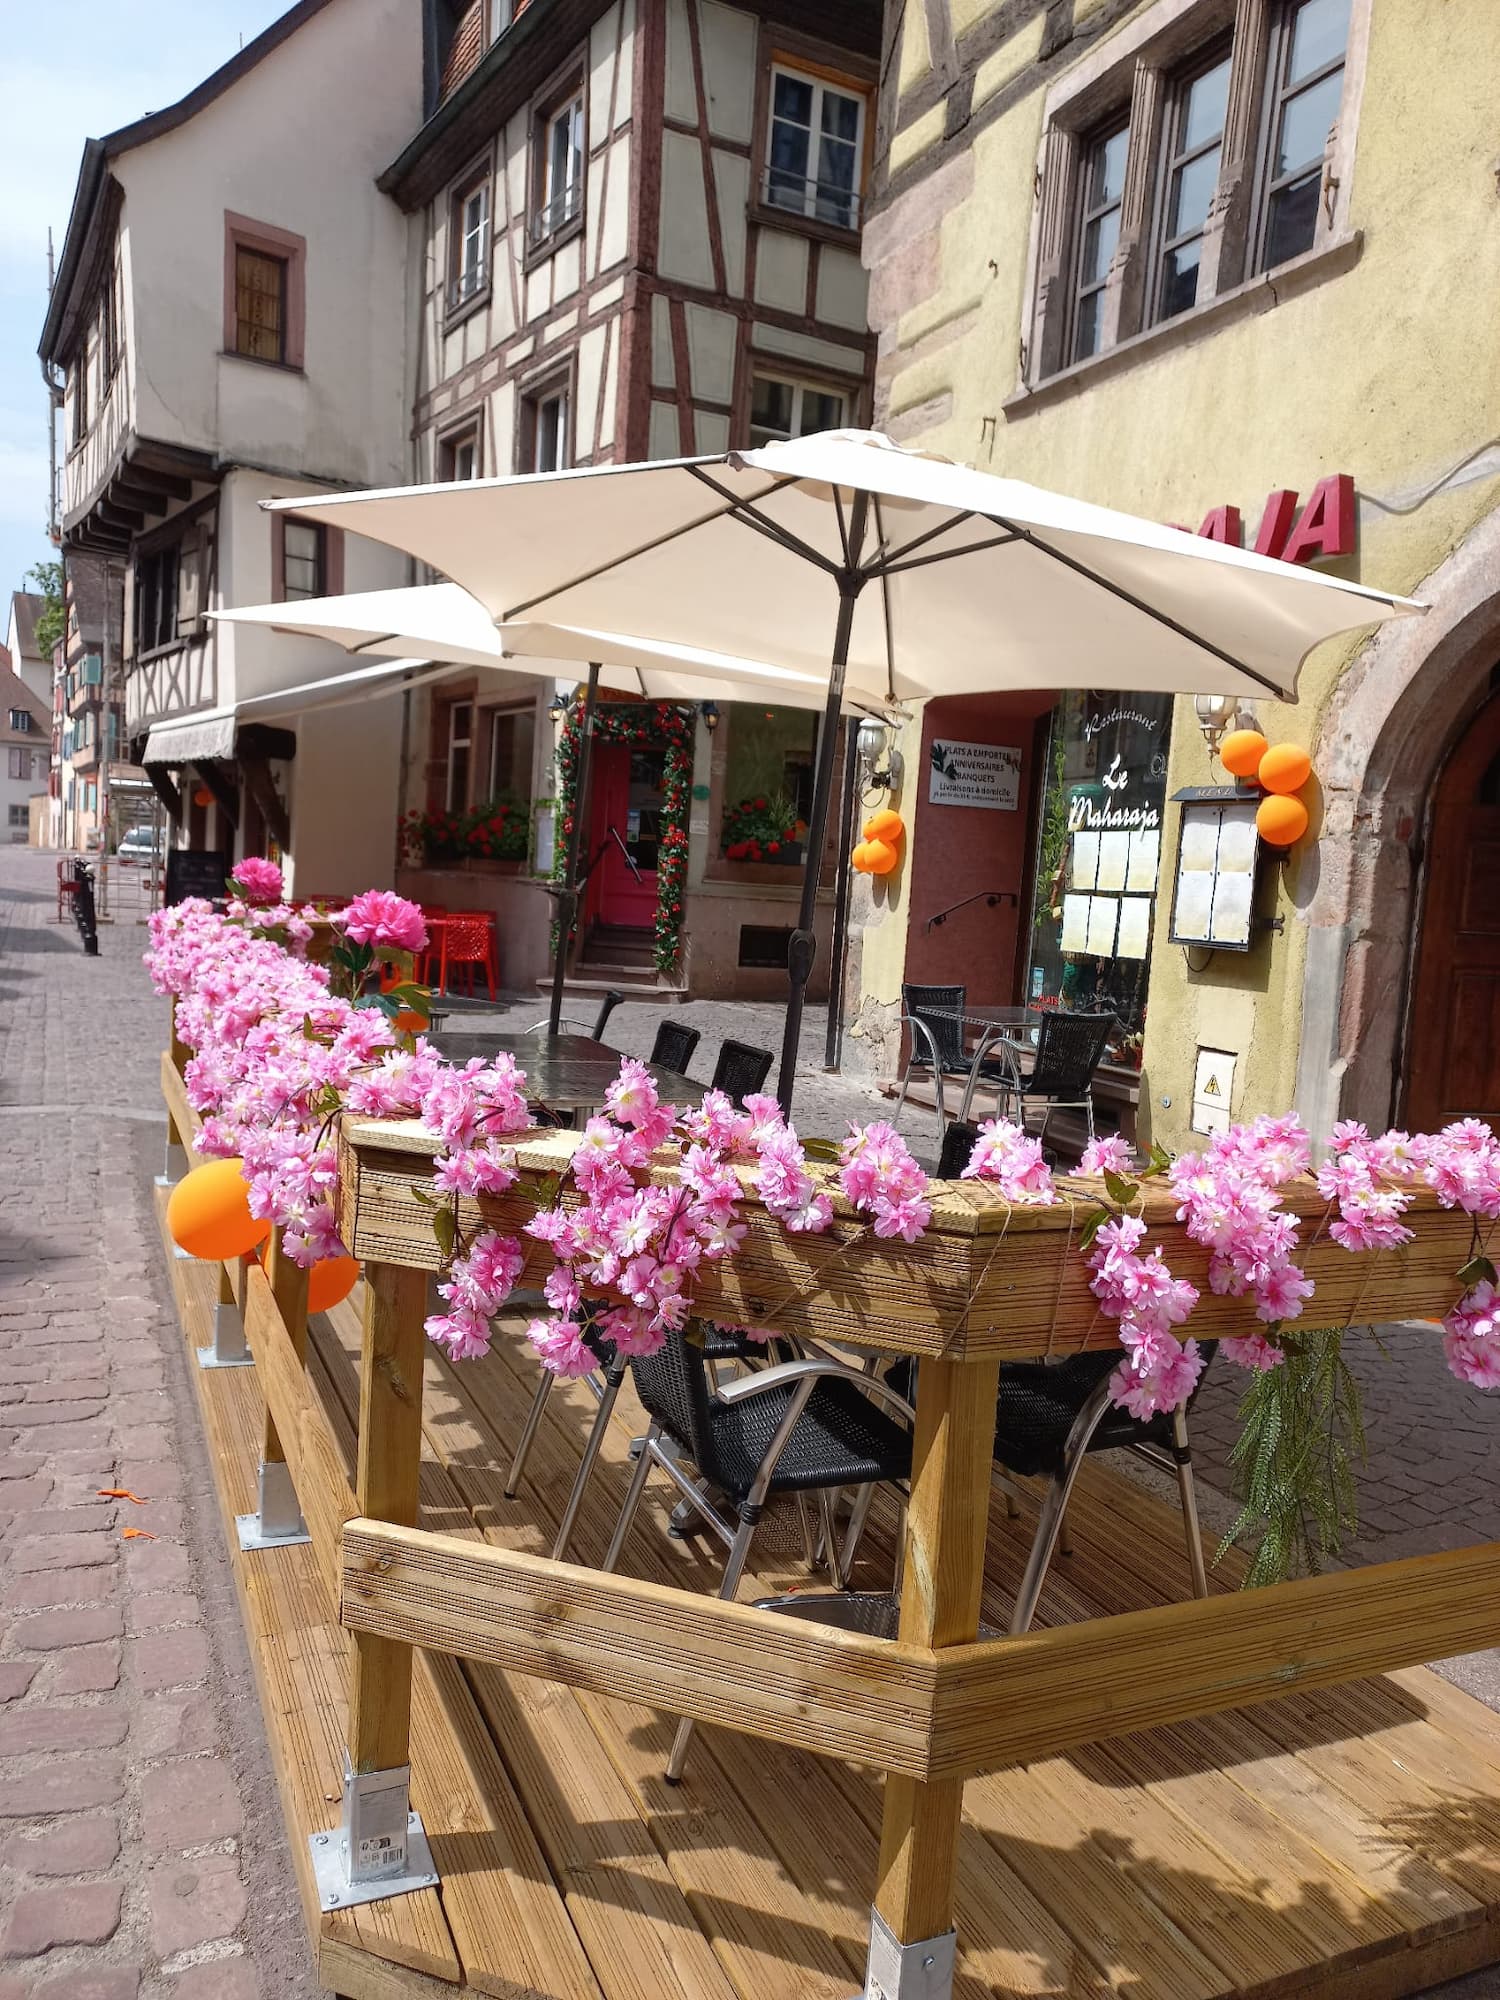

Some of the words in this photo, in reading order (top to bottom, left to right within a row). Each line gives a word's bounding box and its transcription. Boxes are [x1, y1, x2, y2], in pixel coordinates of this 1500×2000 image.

[1085, 708, 1157, 741] Restaurant
[957, 773, 995, 783] BANQUETS
[1102, 753, 1128, 789] Le
[939, 783, 974, 793] Livraisons
[1067, 795, 1160, 840] Maharaja
